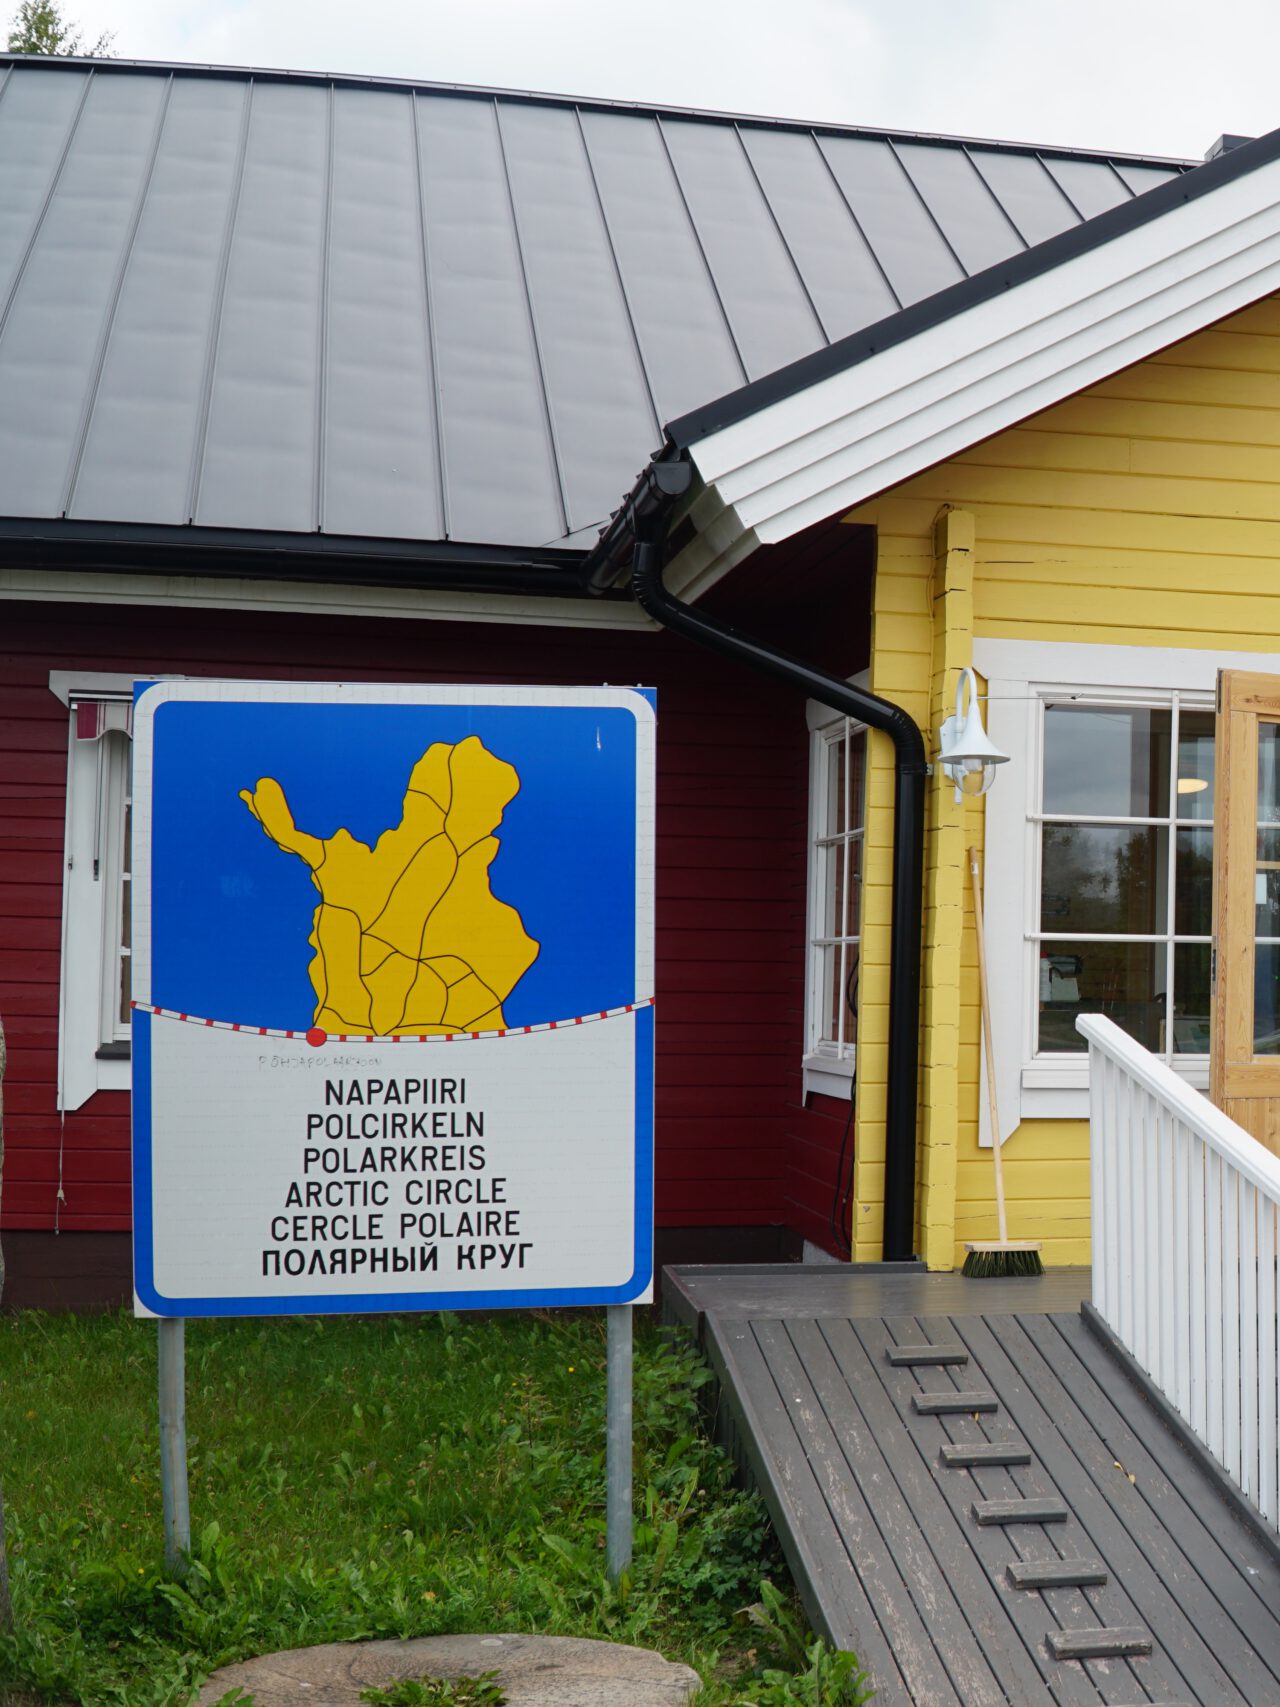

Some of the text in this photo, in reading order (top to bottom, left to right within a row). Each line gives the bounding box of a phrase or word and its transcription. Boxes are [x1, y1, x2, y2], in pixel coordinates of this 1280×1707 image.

[326, 1079, 466, 1105] NAPAPIIRI
[307, 1112, 484, 1139] POLCIRKELN
[304, 1145, 486, 1173] POLARKREIS
[285, 1178, 507, 1207] ARCTIC CIRCLE
[272, 1211, 520, 1241] CERCLE POLAIRE
[262, 1241, 533, 1275] ПОЛЯРНЫЙ КРУГ
